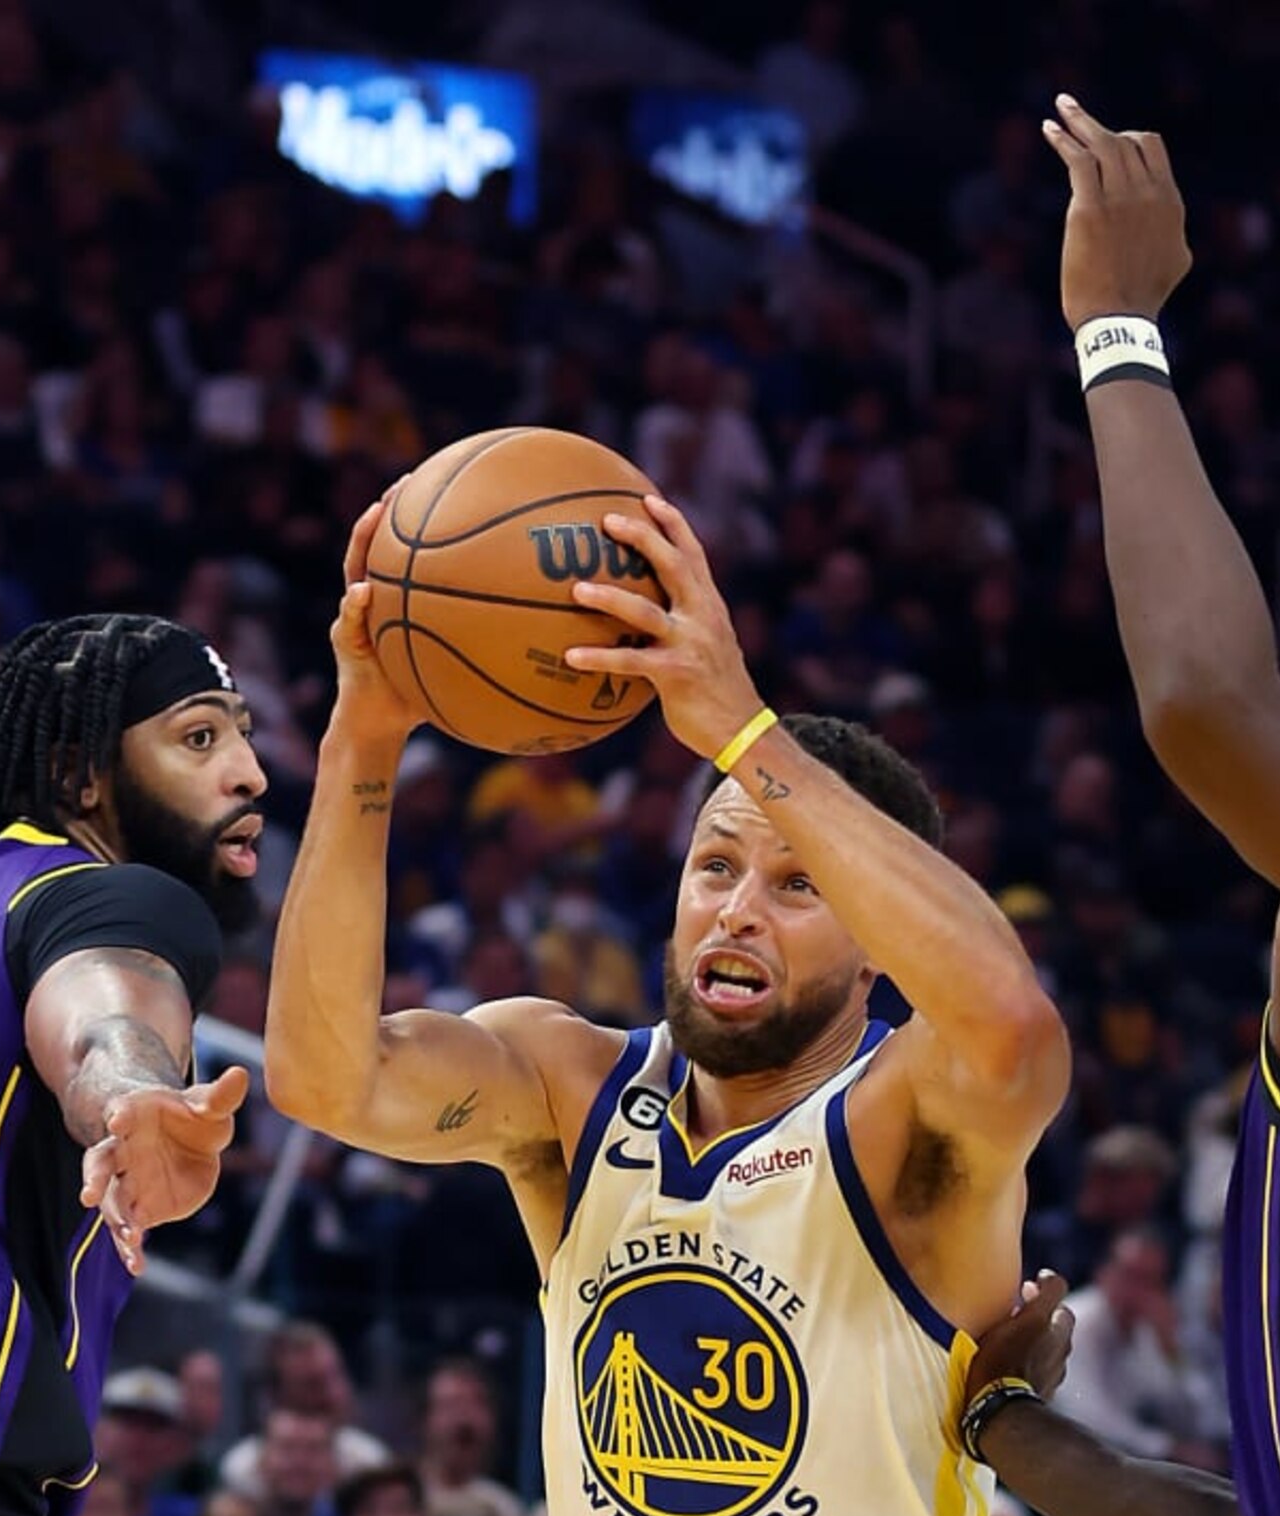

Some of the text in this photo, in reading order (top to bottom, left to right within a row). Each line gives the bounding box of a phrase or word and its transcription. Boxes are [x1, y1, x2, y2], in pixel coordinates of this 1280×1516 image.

[629, 1093, 665, 1126] 6
[727, 1148, 813, 1184] Rakuten
[578, 1231, 806, 1321] GLDEN STATE
[692, 1336, 775, 1412] 30
